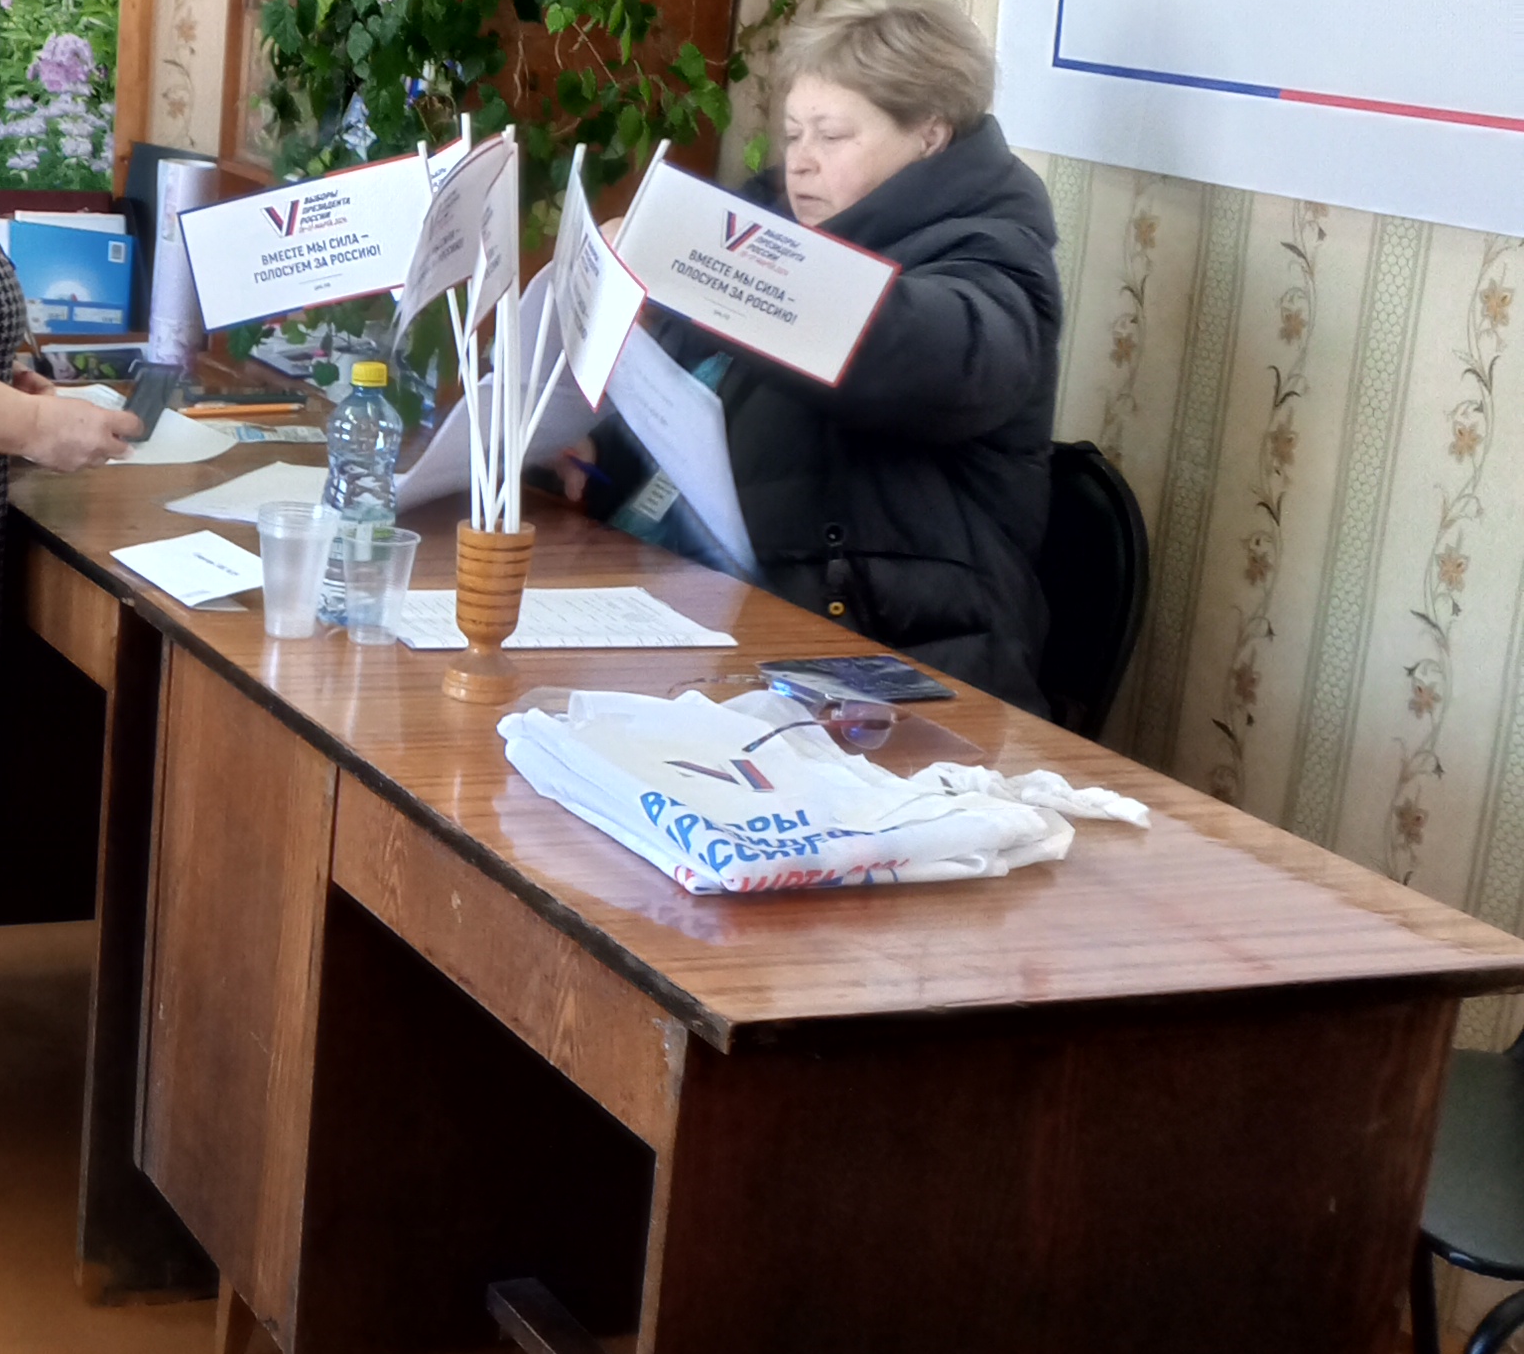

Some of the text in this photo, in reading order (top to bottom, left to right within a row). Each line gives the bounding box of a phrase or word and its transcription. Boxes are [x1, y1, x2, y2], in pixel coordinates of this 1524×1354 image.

[254, 244, 382, 284] ГОЛОСУЕМ ЗА РОССИЮ!
[261, 245, 305, 266] ВМЕСТЕ
[306, 240, 327, 255] МЫ
[329, 233, 360, 250] СИЛА
[671, 259, 730, 294] ГОЛОСУЕМ
[728, 286, 744, 301] ЗА
[745, 294, 798, 325] РОССИЮ!
[688, 249, 733, 278] ВМЕСТЕ
[733, 269, 755, 287] МЫ
[755, 280, 786, 303] СИЛА
